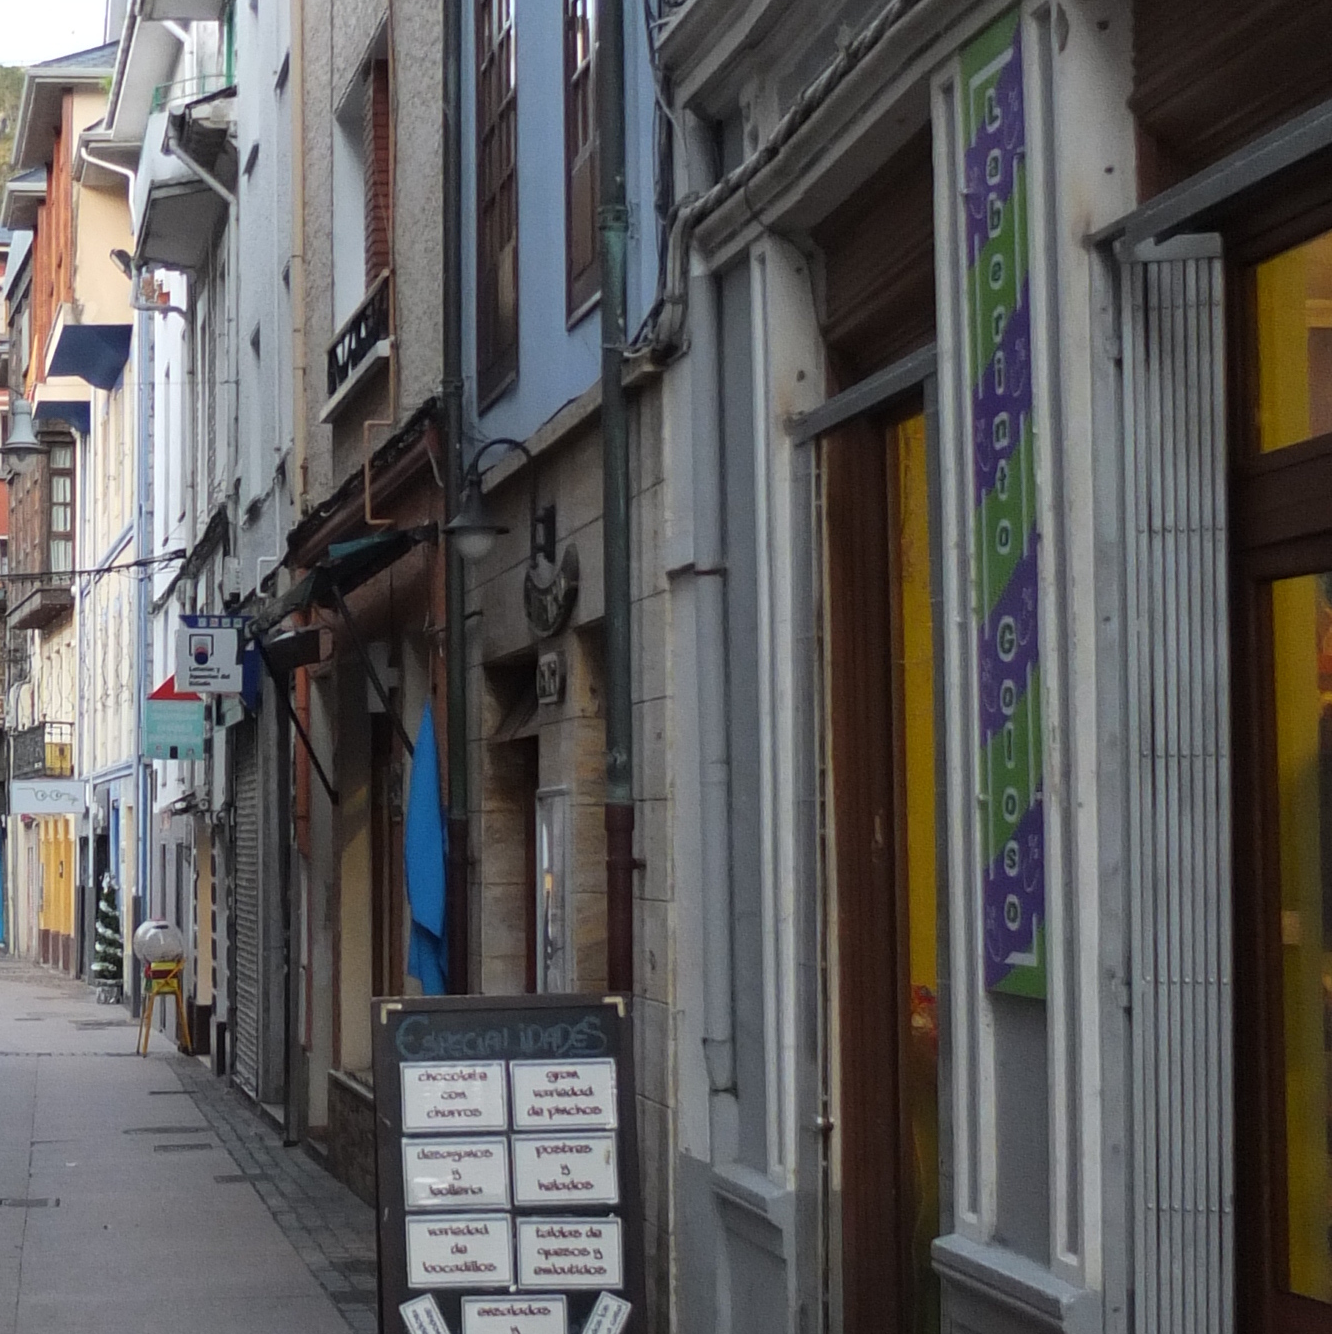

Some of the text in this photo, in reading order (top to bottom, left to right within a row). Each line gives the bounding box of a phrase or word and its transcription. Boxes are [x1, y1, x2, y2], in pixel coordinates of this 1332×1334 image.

[984, 87, 1022, 933] Laberinto Goloso
[418, 1069, 488, 1082] chocolate
[545, 1069, 580, 1083] gran
[533, 1086, 595, 1098] variedad
[426, 1107, 482, 1119] churros
[527, 1105, 603, 1120] de pinchos
[417, 1147, 494, 1162] desayunos
[534, 1143, 593, 1158] postres
[451, 1168, 462, 1181] y
[560, 1164, 571, 1176] y
[538, 1179, 594, 1191] helados
[427, 1223, 490, 1237] variedad
[535, 1226, 603, 1239] tablas de
[451, 1243, 468, 1255] de
[537, 1247, 604, 1261] quesos y
[422, 1261, 497, 1273] bocadillos
[533, 1265, 608, 1276] embutidos
[477, 1304, 552, 1317] ensaladas
